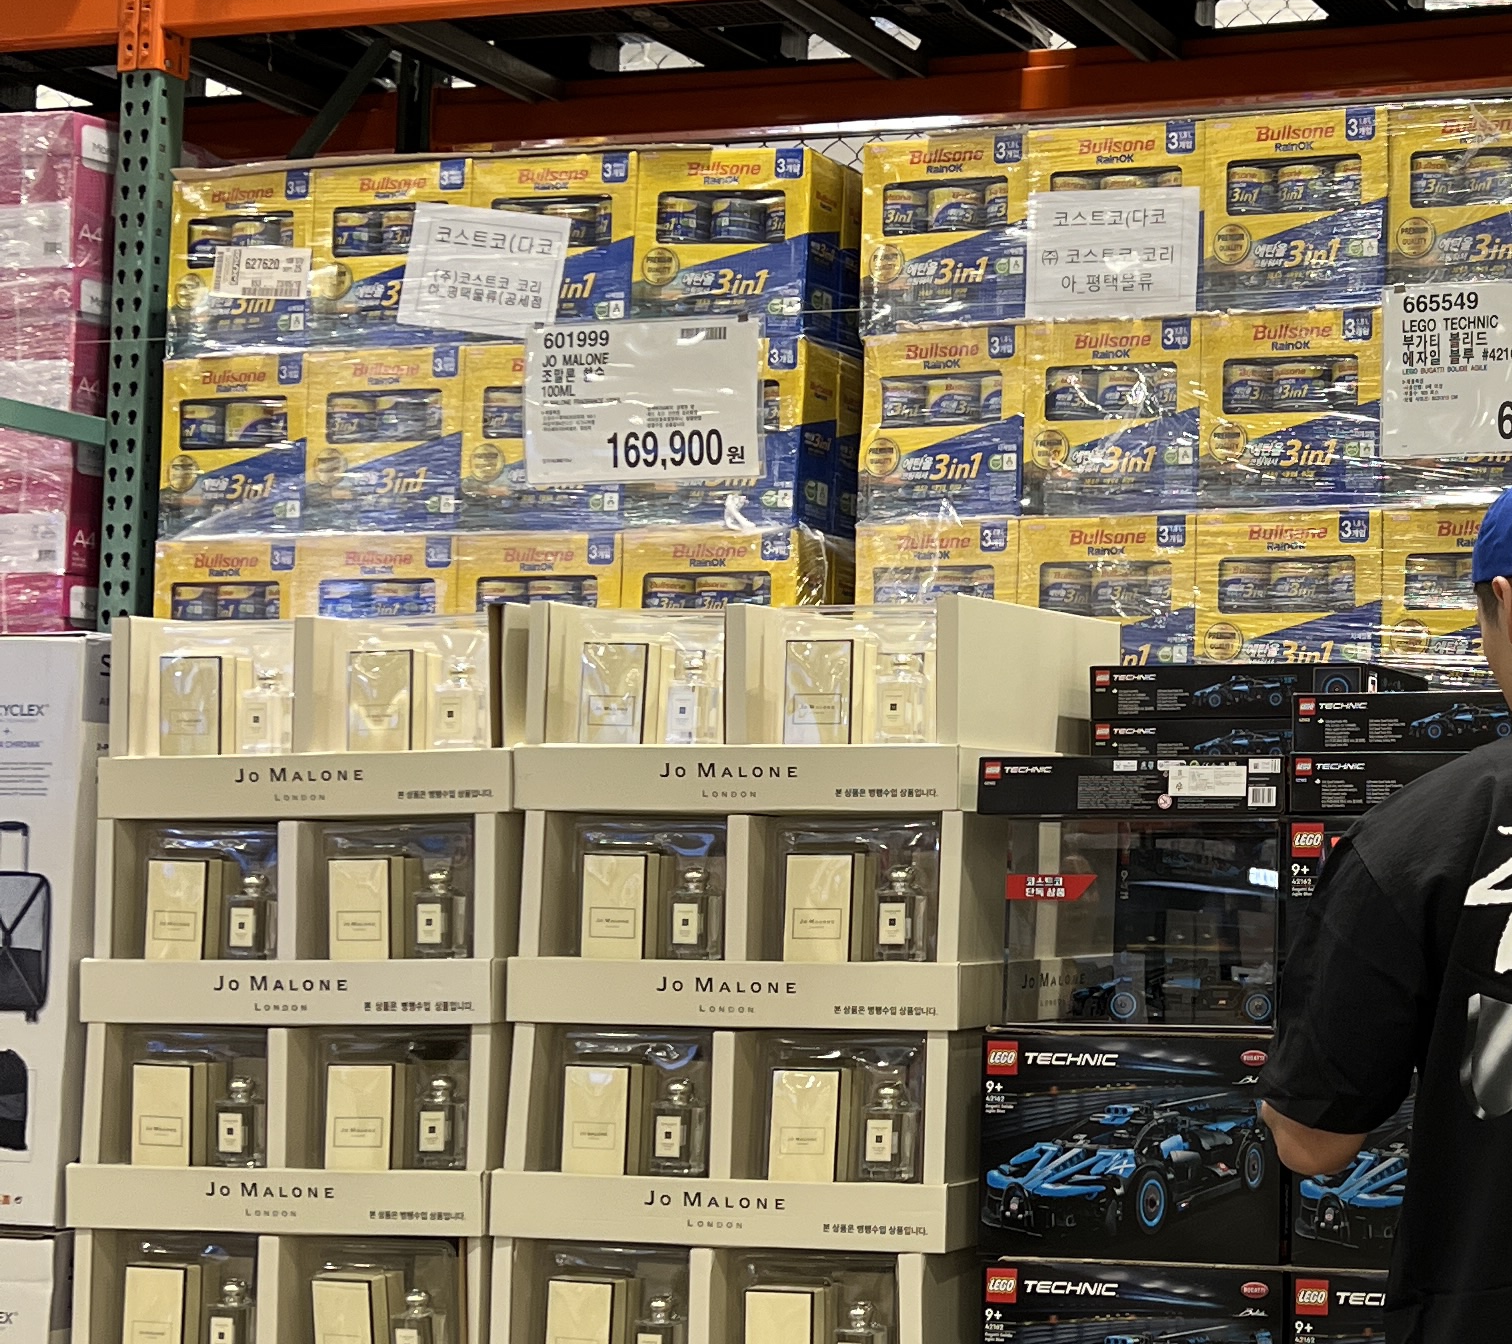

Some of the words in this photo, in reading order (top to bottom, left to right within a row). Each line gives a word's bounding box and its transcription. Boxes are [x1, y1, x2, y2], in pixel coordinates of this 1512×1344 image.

[1256, 124, 1334, 143] Bullsone
[1078, 137, 1155, 155] Bullsone
[1053, 208, 1166, 228] 코스트코(다코
[435, 226, 553, 255] 코스트코(다코
[1142, 246, 1174, 264] 코리
[516, 279, 541, 294] 코리
[1062, 273, 1153, 294] 아_평택물류
[1403, 292, 1478, 313] 665549
[1402, 319, 1436, 333] LEGO
[1444, 315, 1498, 331] TECHNIC
[544, 330, 609, 349] 601999
[1075, 333, 1151, 350] Bullsone
[1402, 333, 1440, 350] 부가티
[1449, 331, 1488, 348] 볼리드
[542, 355, 556, 367] JO
[563, 353, 609, 367] MALONE
[906, 343, 979, 361] Bullsone
[1402, 349, 1440, 368] 에자일
[1449, 347, 1474, 364] 블루
[541, 385, 575, 397] 100ML
[234, 769, 260, 783] Jo
[270, 768, 364, 782] Malone
[660, 762, 686, 778] Jo
[698, 762, 798, 778] Malone
[844, 789, 866, 797] 상품은
[1293, 831, 1322, 849] LEGO
[989, 1050, 1016, 1065] LEGO
[1025, 1052, 1118, 1067] TECHNIC
[986, 1081, 1003, 1093] 9+
[988, 1278, 1015, 1292] LEGO
[1024, 1280, 1118, 1296] TECHNIC
[1298, 1290, 1326, 1304] LEGO
[985, 1309, 1002, 1321] 9+
[1296, 1322, 1313, 1333] 9+
